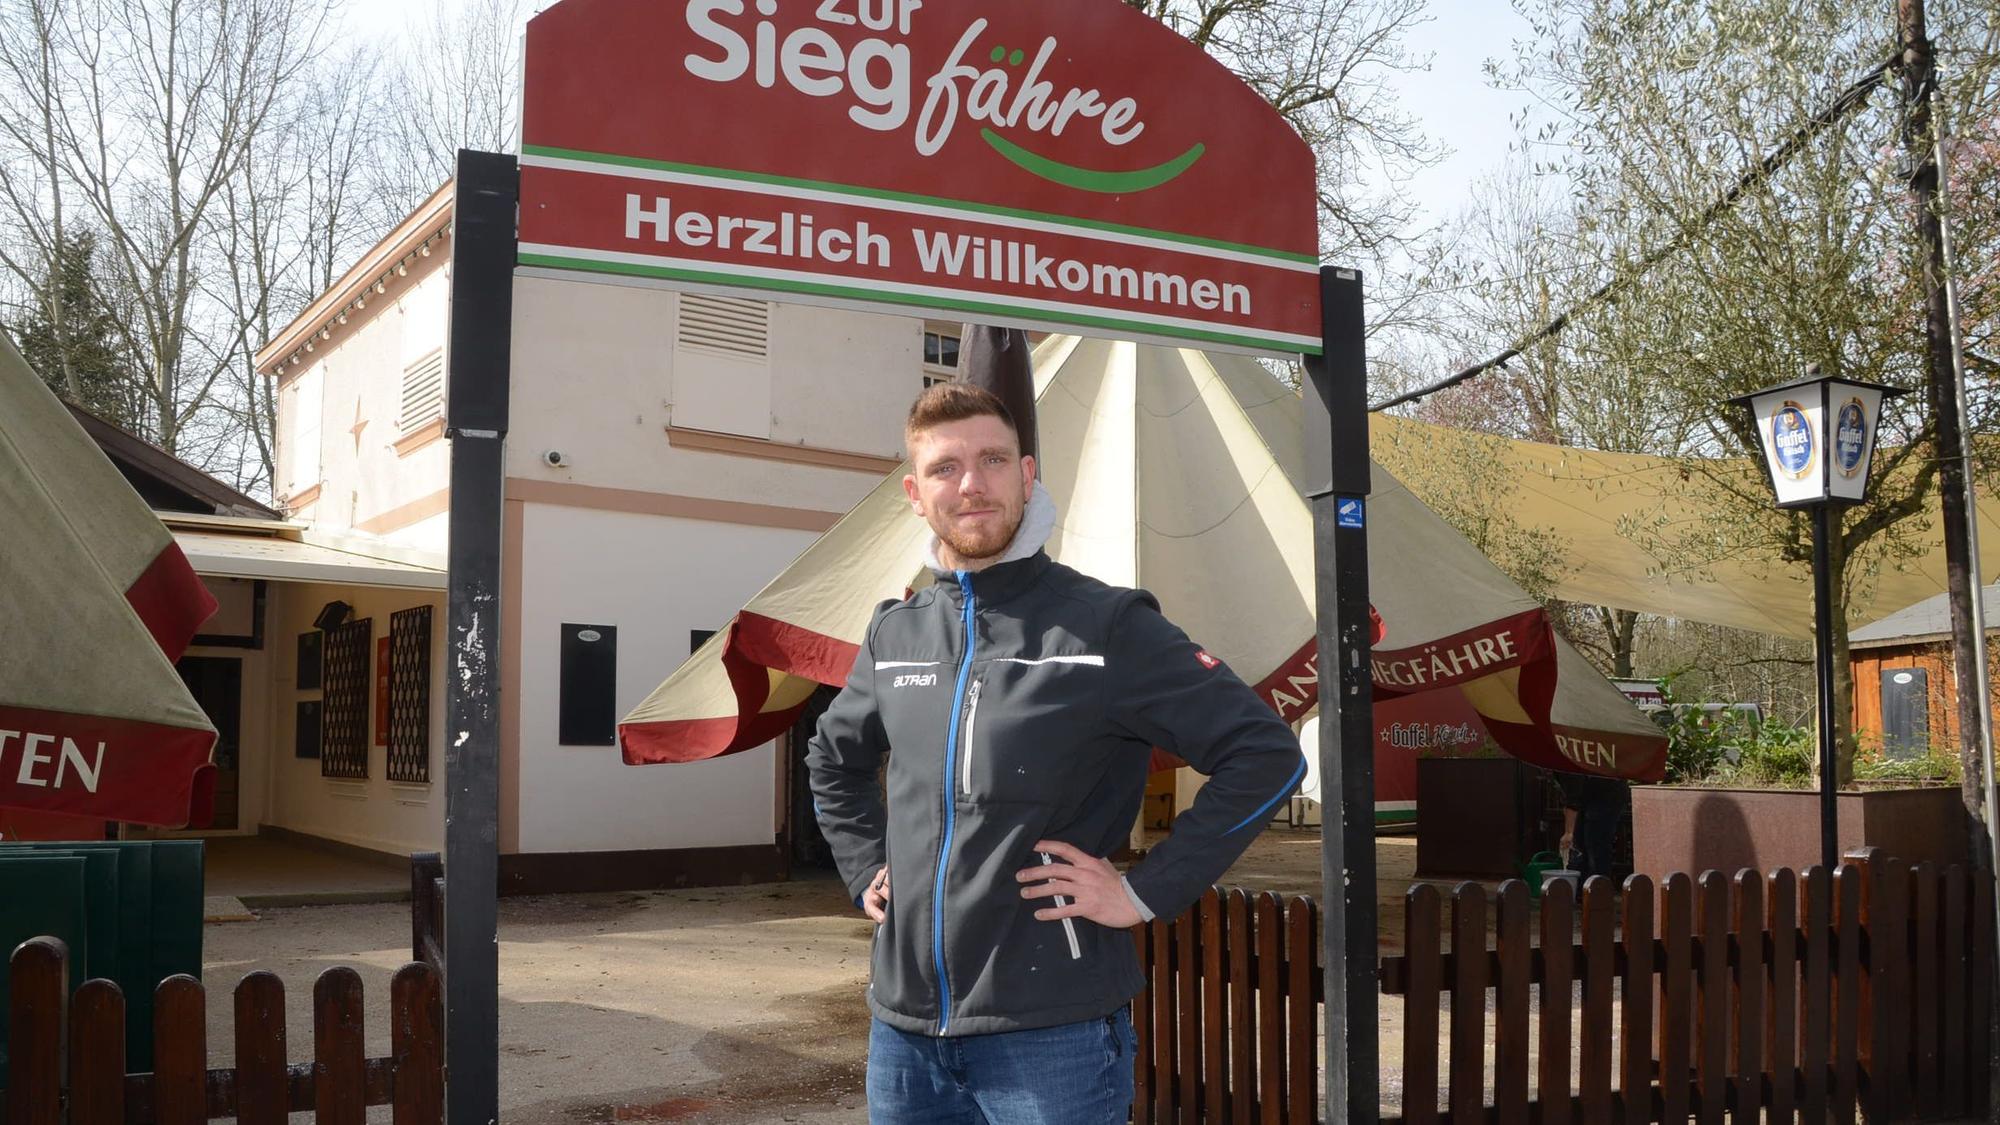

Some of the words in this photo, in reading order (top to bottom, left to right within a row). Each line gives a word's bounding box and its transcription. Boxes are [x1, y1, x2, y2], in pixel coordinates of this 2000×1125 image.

[624, 193, 890, 267] Herzlich
[912, 228, 1251, 316] Willkommen
[1775, 428, 1808, 448] Gaffel
[1391, 722, 1431, 750] Gaffel
